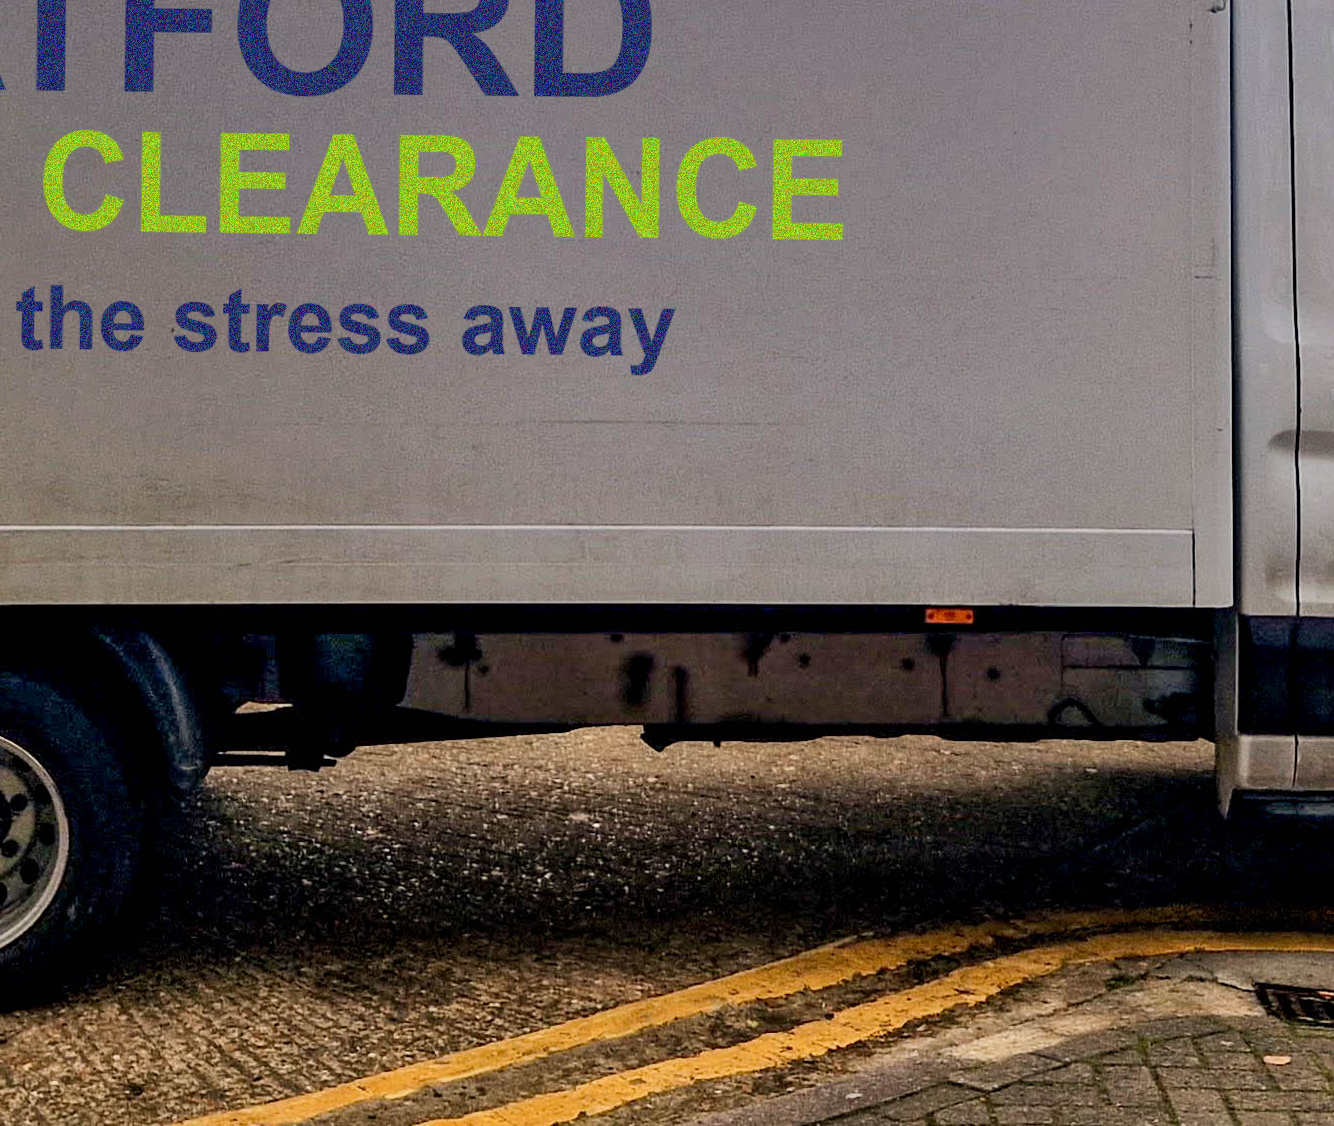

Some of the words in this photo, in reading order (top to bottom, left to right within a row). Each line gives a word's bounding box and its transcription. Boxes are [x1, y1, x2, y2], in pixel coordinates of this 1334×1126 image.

[41, 128, 846, 243] CLEARANCE
[16, 285, 145, 351] the
[174, 290, 431, 356] stress
[461, 305, 675, 376] away
